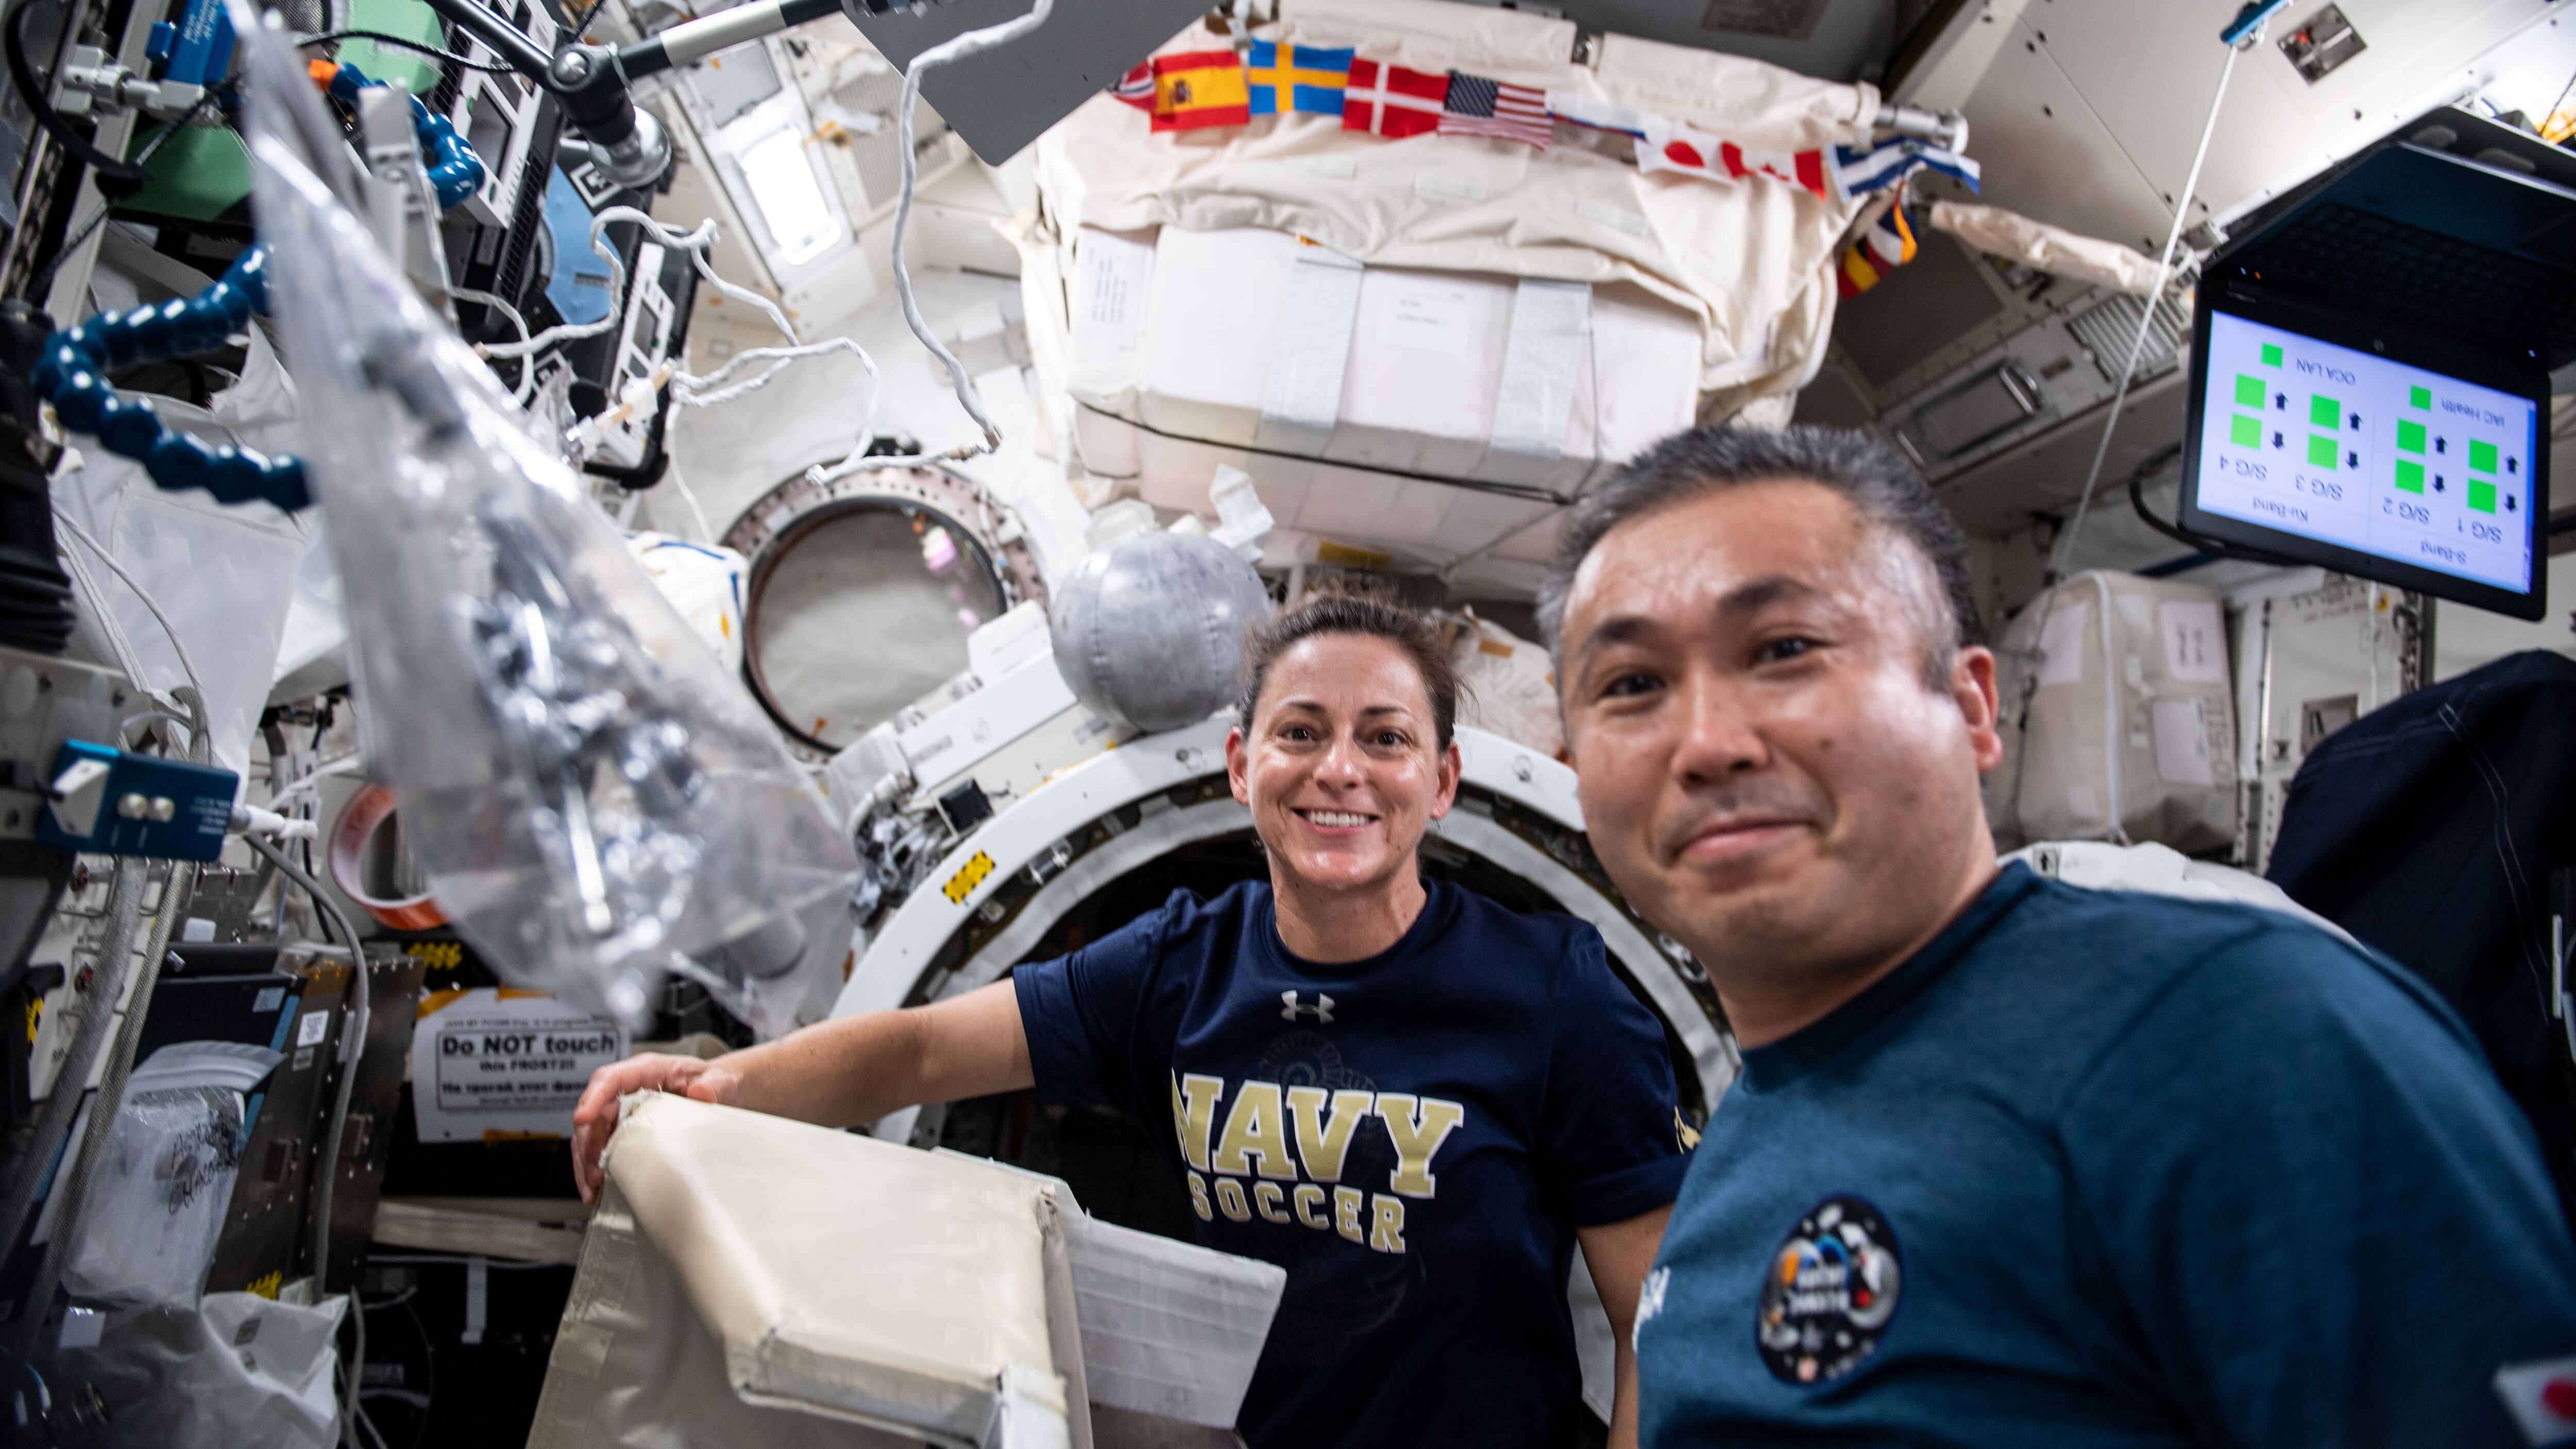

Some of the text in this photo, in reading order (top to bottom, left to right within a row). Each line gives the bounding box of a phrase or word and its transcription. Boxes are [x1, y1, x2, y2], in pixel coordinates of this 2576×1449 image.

[2296, 357, 2322, 378] LAN
[2441, 398, 2480, 421] Health
[2219, 453, 2268, 481] S/G 4
[2295, 473, 2343, 502] S/G 3
[2253, 496, 2309, 523] Ku-Band
[2383, 496, 2430, 525] S/G 2
[2458, 516, 2502, 544] S/G 1
[2421, 539, 2467, 565] S-Band
[443, 1033, 615, 1055] Do NOT touch
[1172, 1068, 1464, 1199] NAVY
[1188, 1171, 1405, 1253] SOCCER
